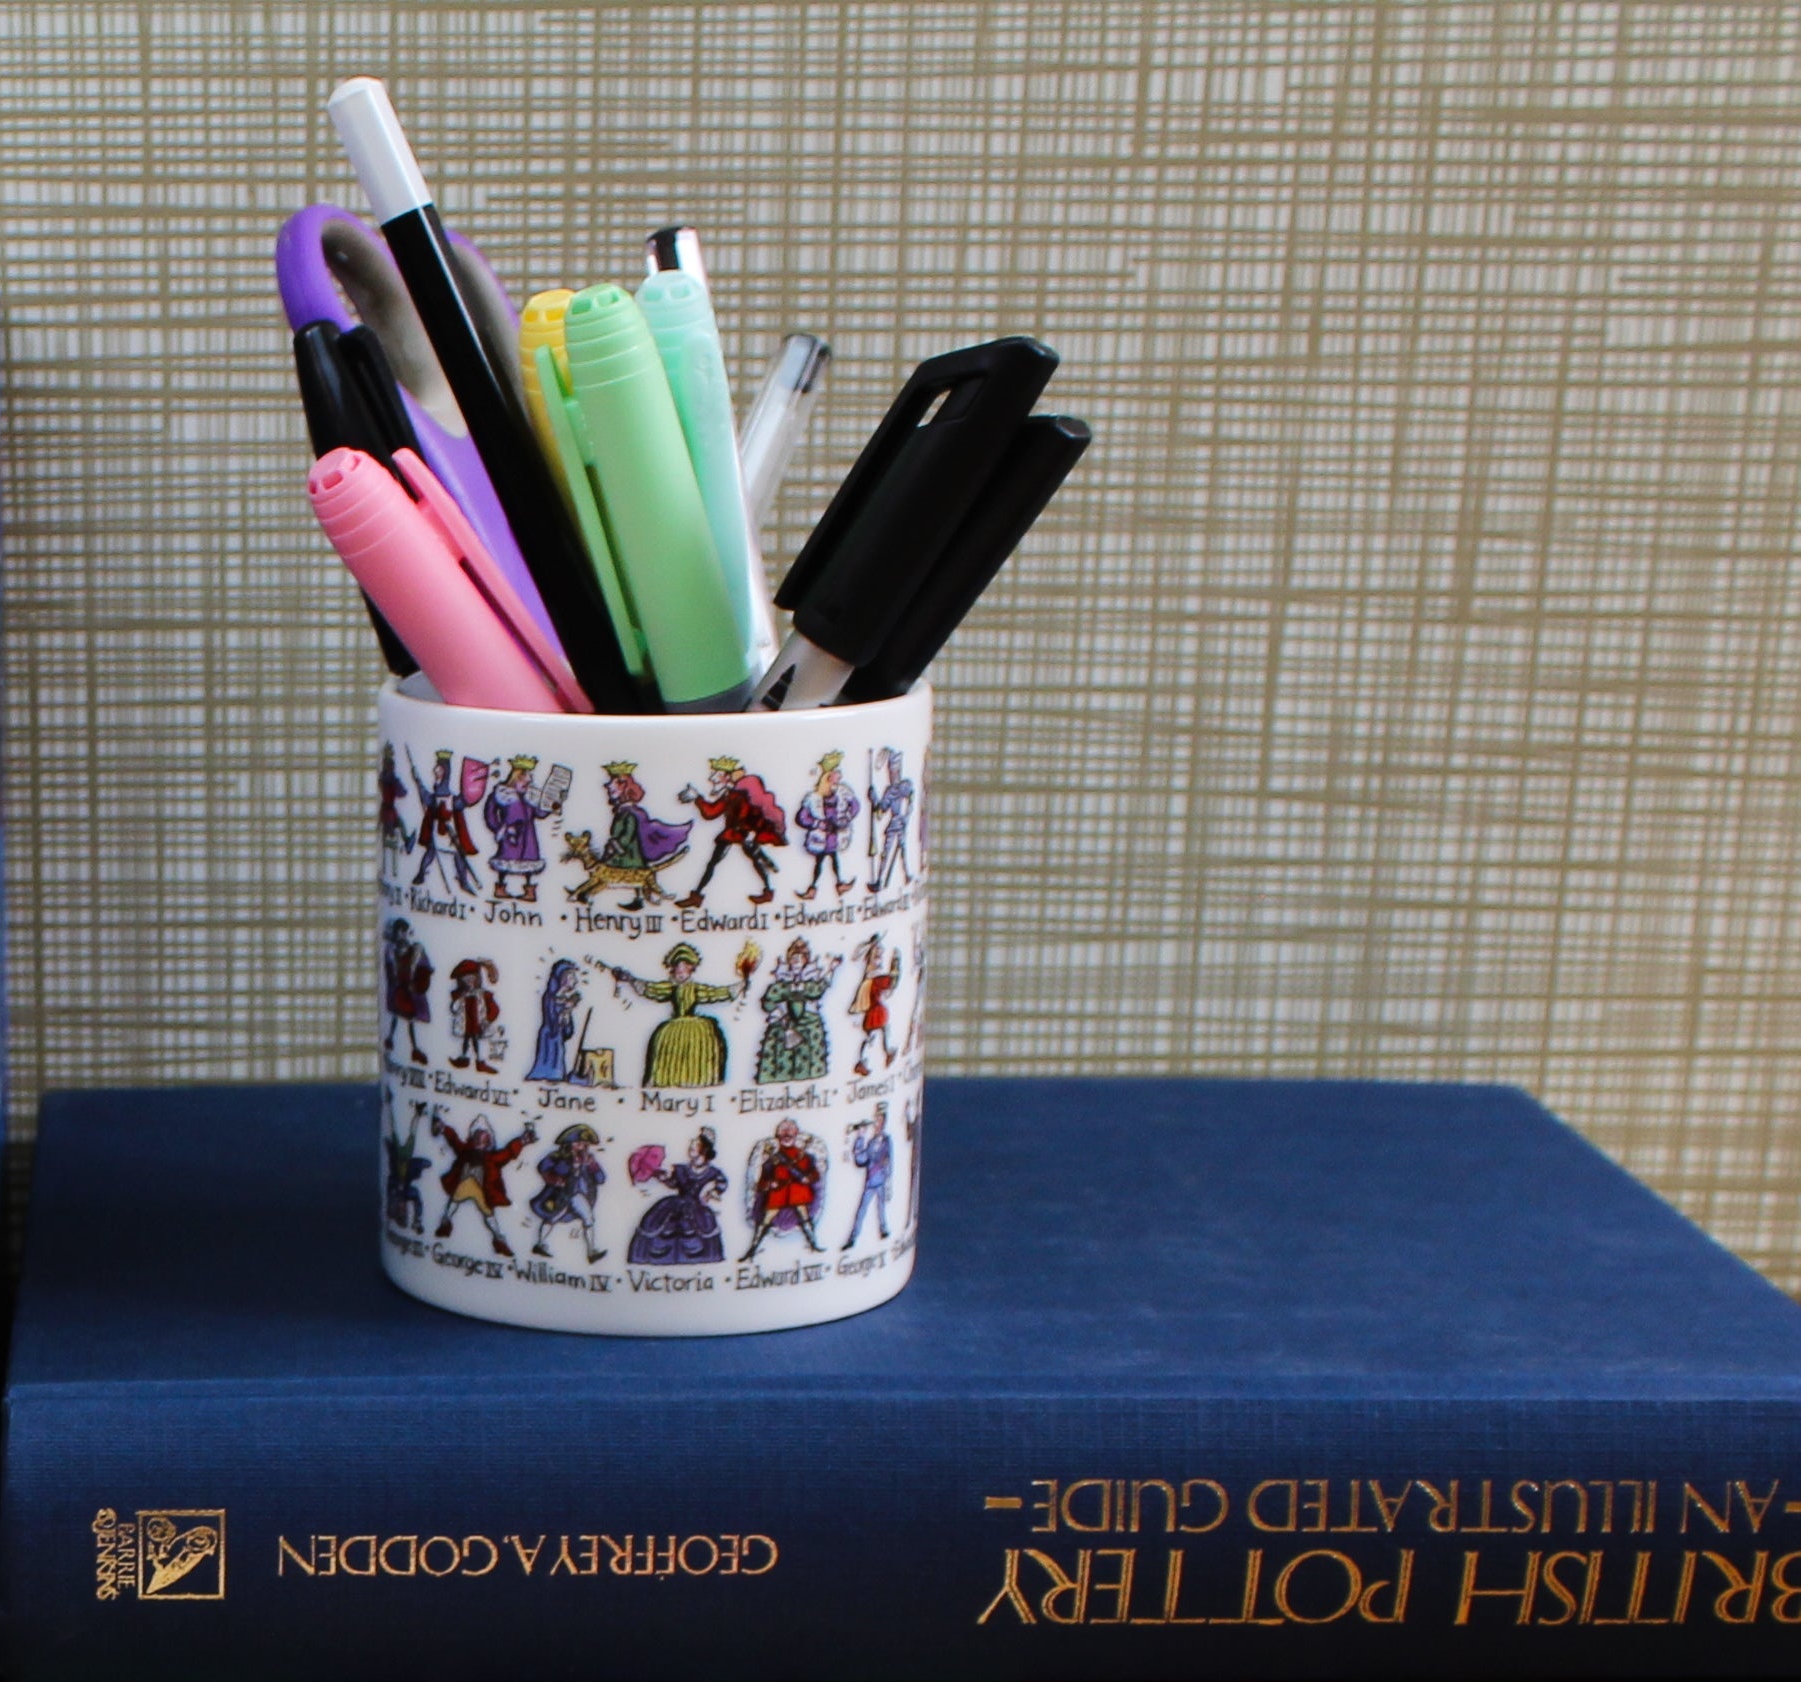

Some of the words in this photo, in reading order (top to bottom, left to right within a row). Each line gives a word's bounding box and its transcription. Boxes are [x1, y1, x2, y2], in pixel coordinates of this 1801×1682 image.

[484, 899, 543, 927] John
[575, 904, 643, 940] Henry
[681, 909, 758, 933] Edward
[539, 1086, 597, 1113] Jane
[640, 1091, 699, 1118] Mary
[512, 1259, 586, 1289] William
[627, 1267, 714, 1292] Victoria
[1030, 1478, 1230, 1533] GUIDE
[1248, 1478, 1657, 1533] ILLUSTRATED
[1681, 1479, 1780, 1534] AN
[278, 1533, 499, 1577] GODDEN
[550, 1533, 779, 1578] GEOFFREY
[977, 1547, 1415, 1625] POTTERY
